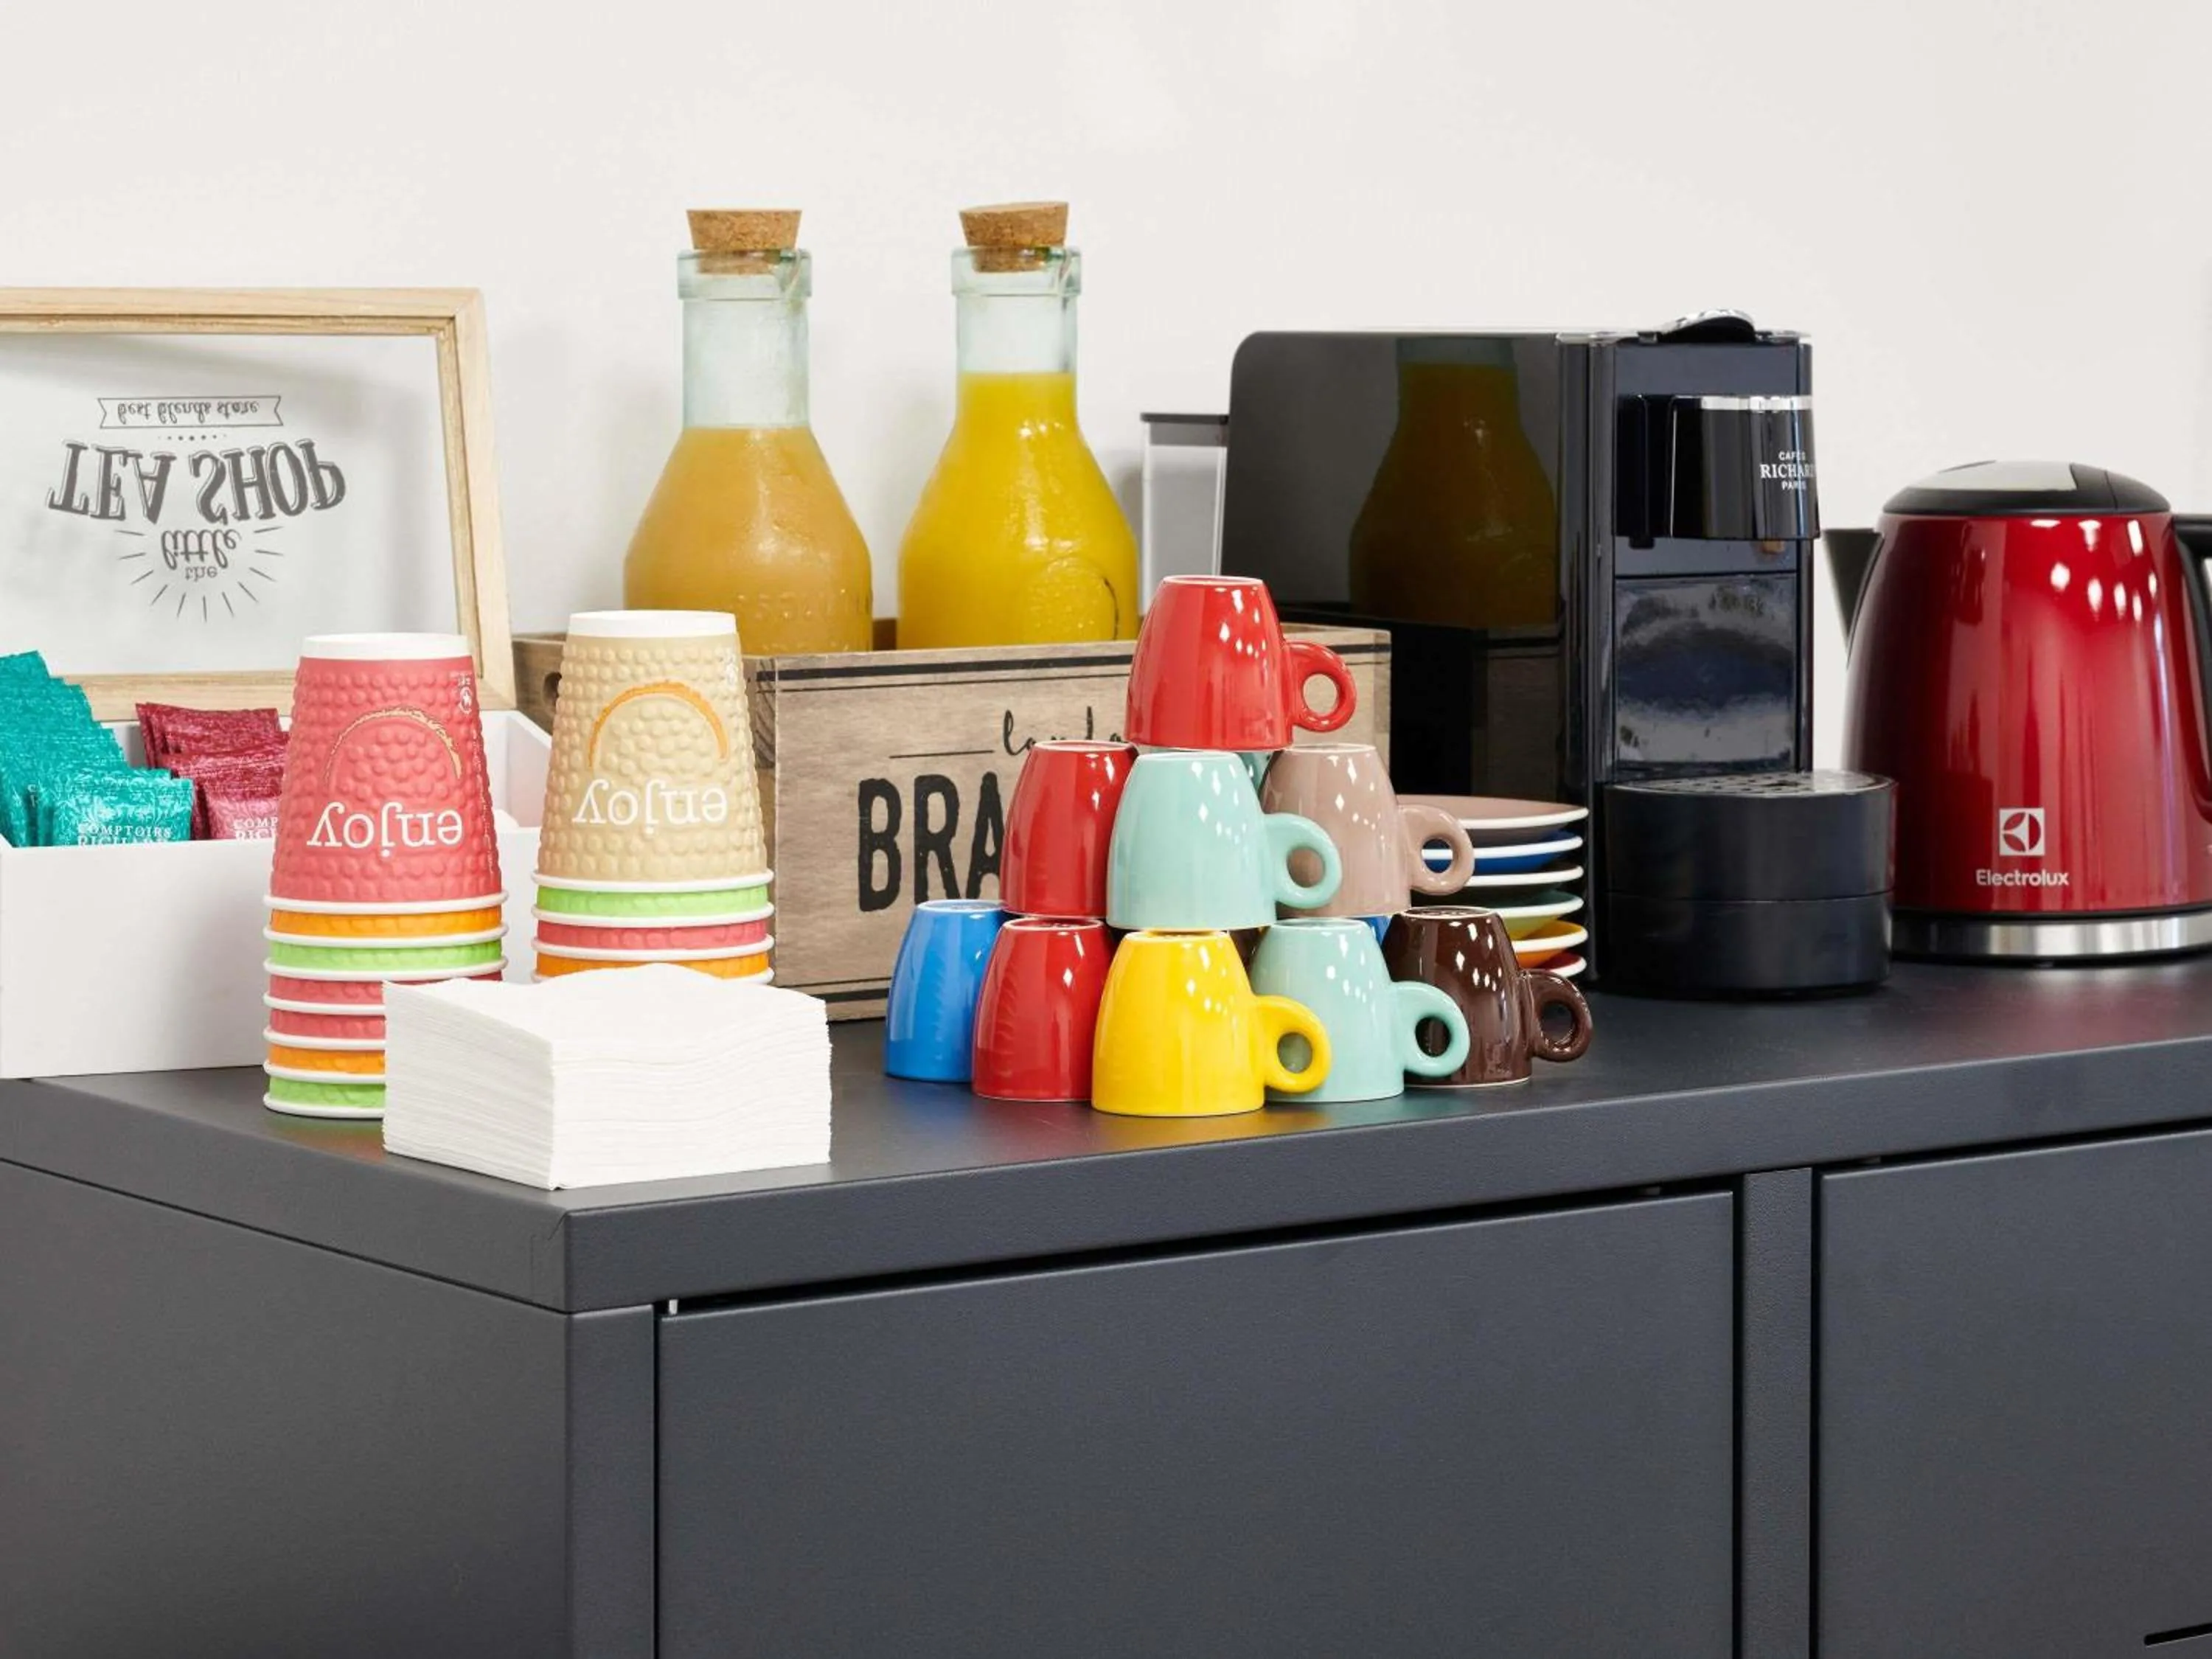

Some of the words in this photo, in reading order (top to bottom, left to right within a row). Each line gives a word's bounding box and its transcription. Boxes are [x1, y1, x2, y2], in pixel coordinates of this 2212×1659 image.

[571, 778, 729, 835] enjoy
[77, 824, 173, 838] COMPTOIRS
[306, 801, 464, 858] enjoy
[1975, 869, 2070, 886] Electrolux
